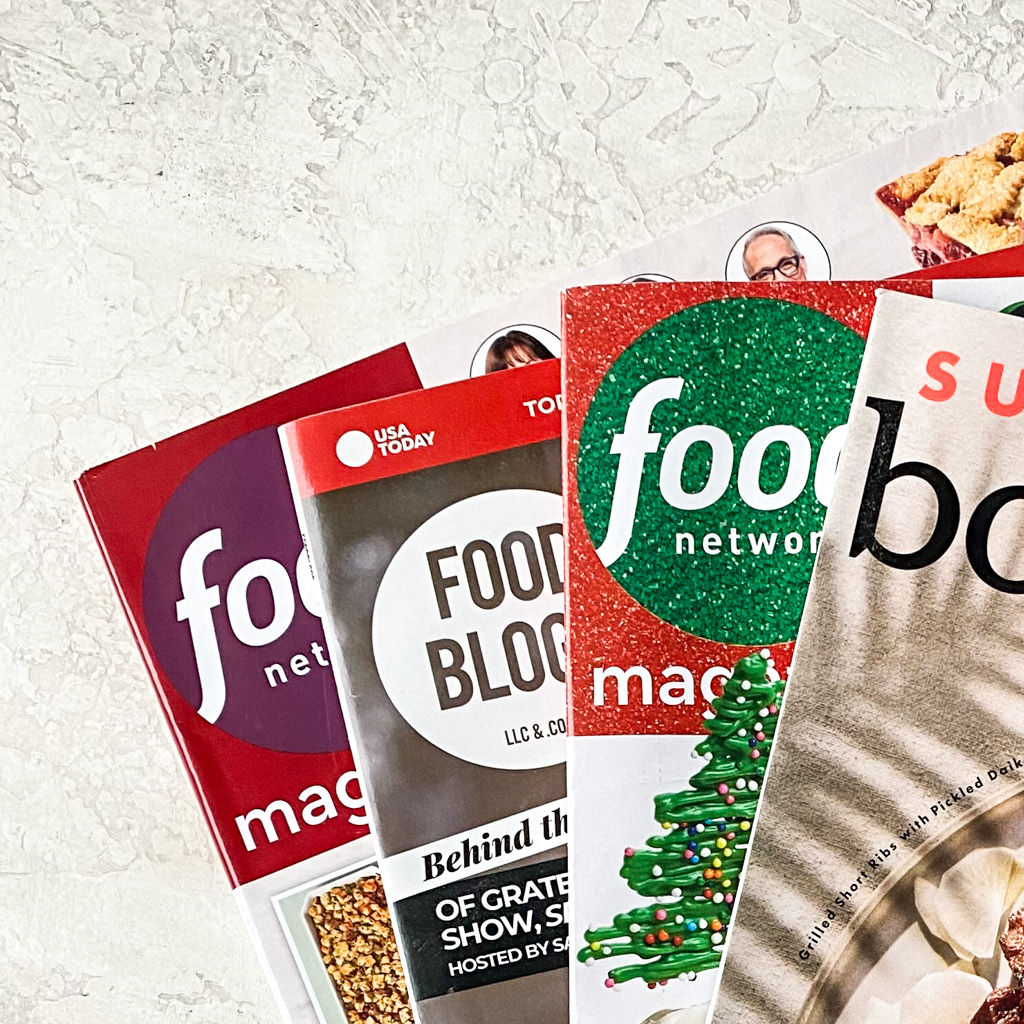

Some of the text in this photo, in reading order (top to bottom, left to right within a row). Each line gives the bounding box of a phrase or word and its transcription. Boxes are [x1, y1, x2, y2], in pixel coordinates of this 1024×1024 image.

[374, 423, 411, 443] USA
[378, 431, 435, 456] TODAY
[675, 528, 824, 556] networ
[426, 523, 565, 620] FOOD
[264, 641, 330, 687] net
[504, 726, 531, 746] LLC
[533, 723, 545, 739] &
[235, 770, 370, 851] mag
[421, 818, 533, 882] Behind
[799, 909, 837, 962] Grilled
[835, 872, 869, 908] Short
[868, 842, 898, 870] Ribs
[900, 815, 930, 841] with
[930, 776, 984, 817] Pickled
[435, 893, 475, 922] OF
[441, 909, 542, 951] SHOW,
[447, 946, 523, 977] HOSTED
[525, 940, 550, 960] BY
